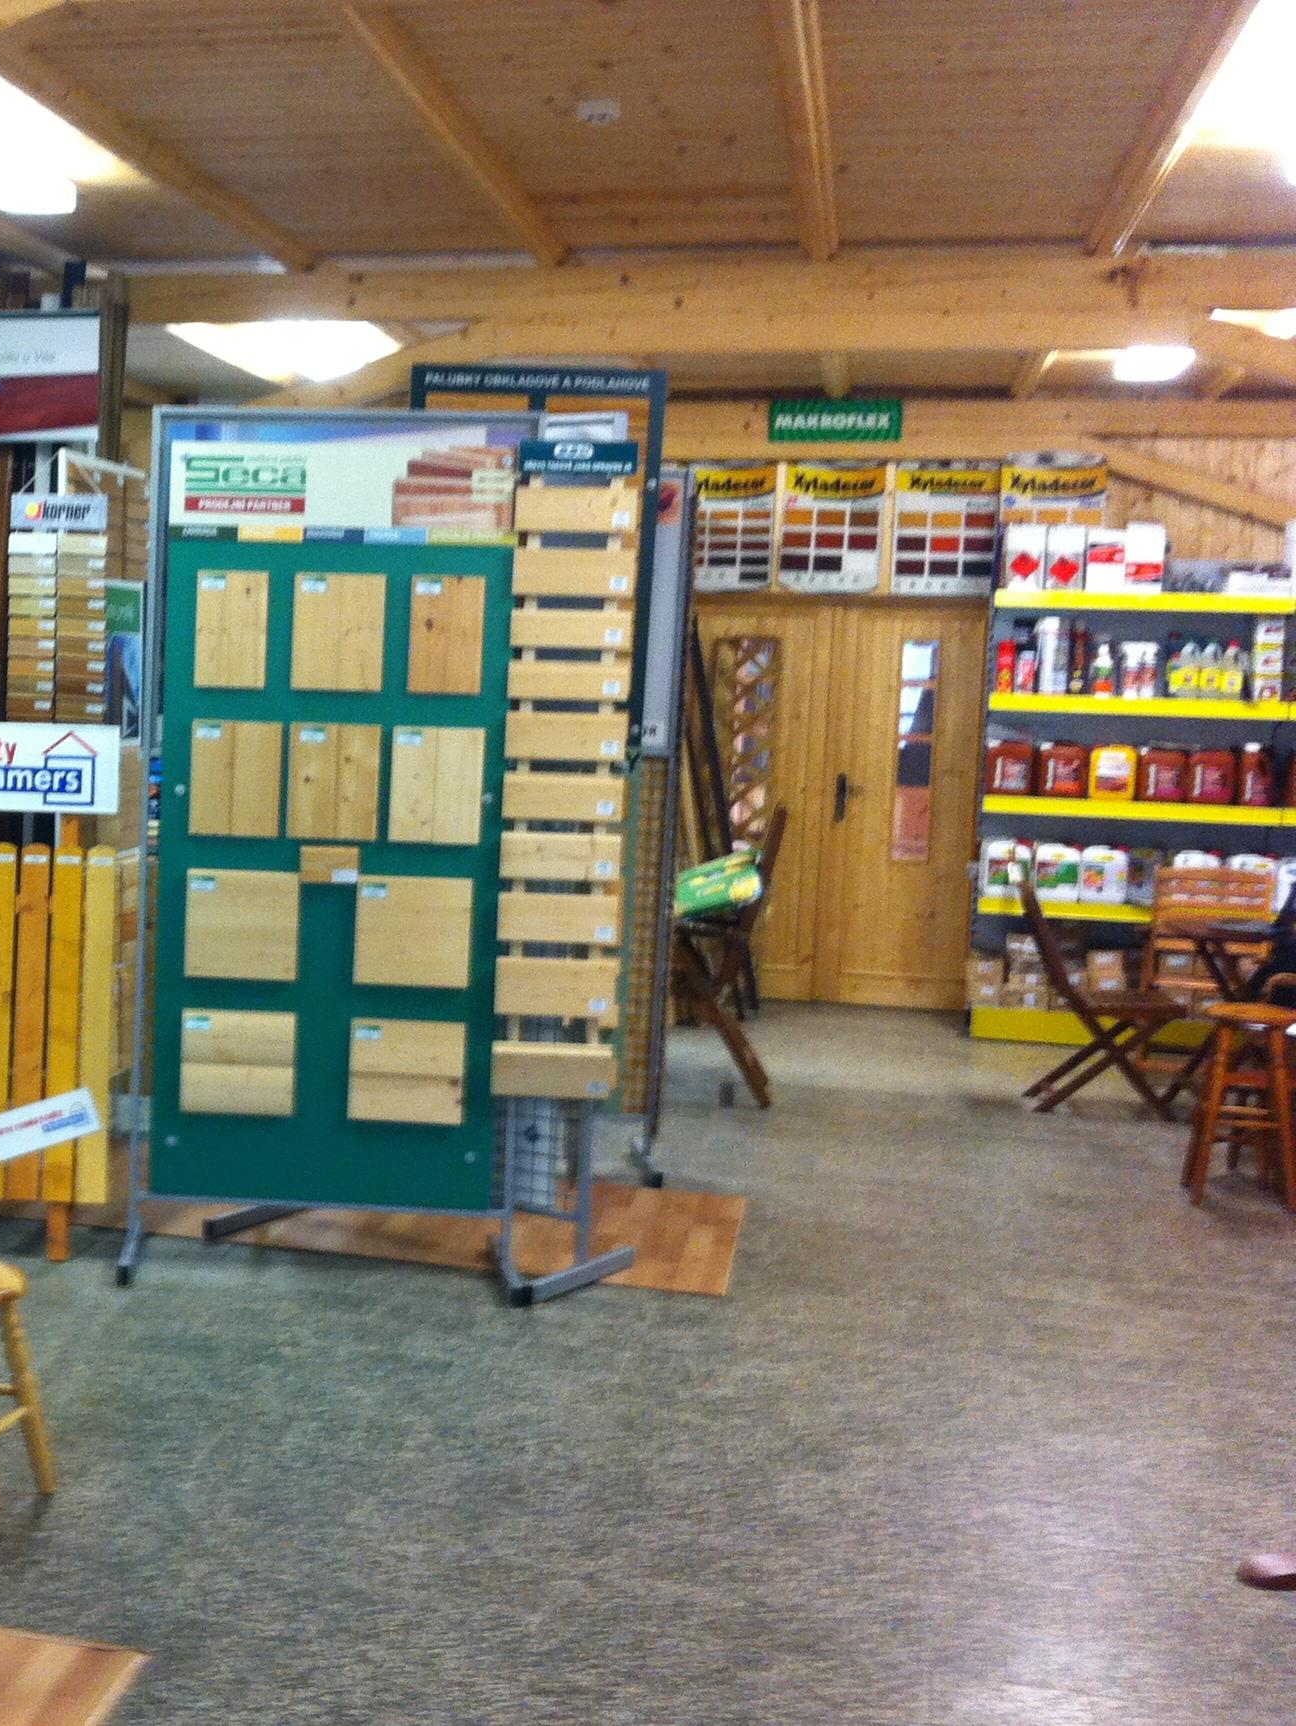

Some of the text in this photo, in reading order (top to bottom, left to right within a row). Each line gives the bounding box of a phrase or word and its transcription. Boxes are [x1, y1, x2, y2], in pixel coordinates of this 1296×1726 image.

[774, 411, 891, 430] MAKROFLEX
[794, 472, 876, 493] Xyladecor
[910, 474, 986, 491] Xyladecor
[1011, 472, 1097, 493] Xyladecor
[42, 501, 91, 521] korner
